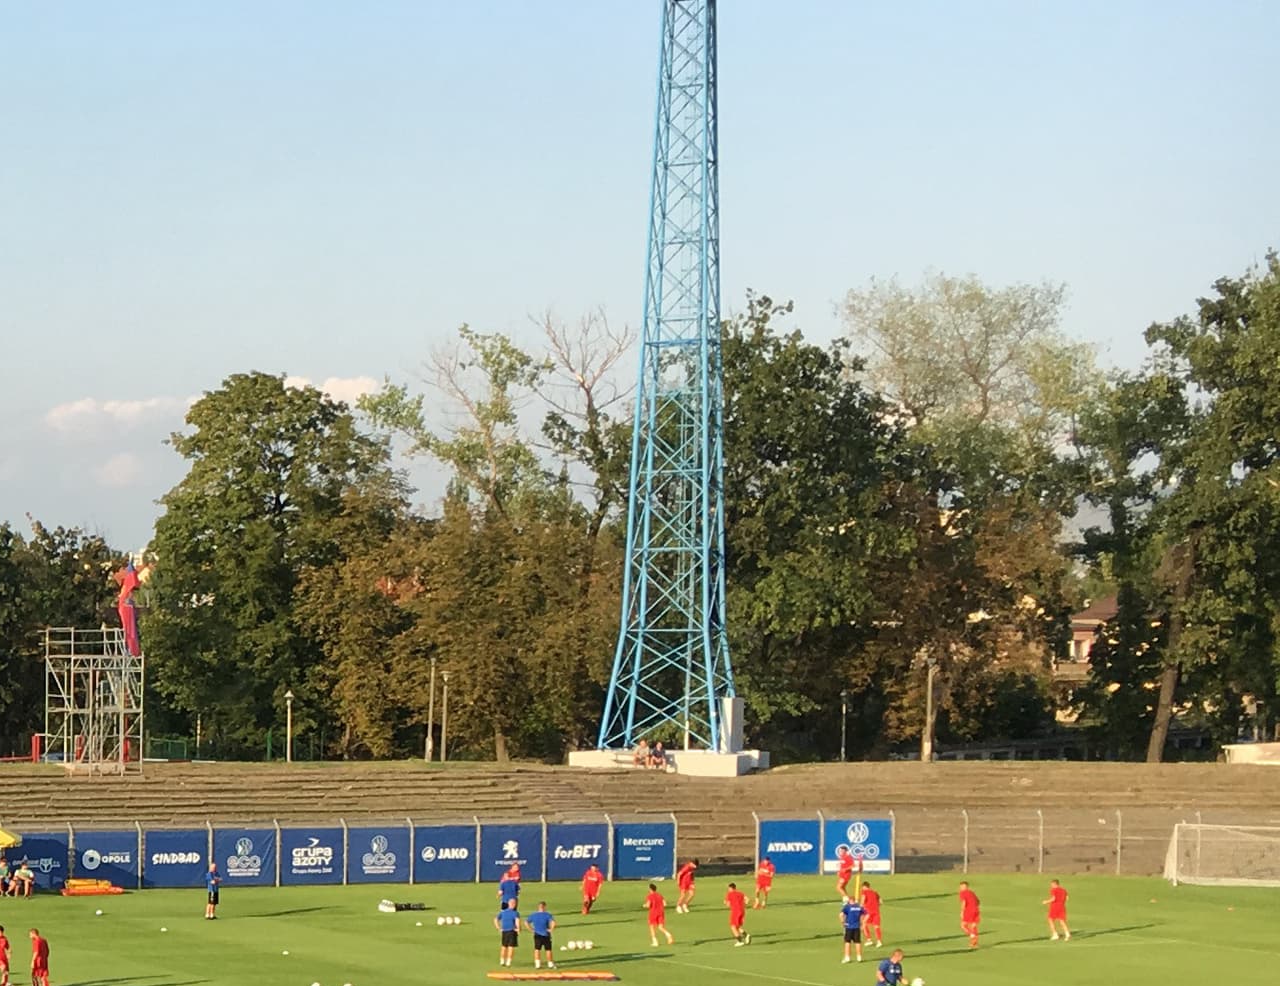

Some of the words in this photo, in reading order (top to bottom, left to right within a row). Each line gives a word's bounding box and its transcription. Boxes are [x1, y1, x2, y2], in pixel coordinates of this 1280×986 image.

[623, 837, 665, 846] Mercure
[152, 851, 201, 865] SINDBAD
[437, 848, 469, 860] JAKO
[554, 844, 602, 860] forBET
[101, 855, 131, 863] OPOLE
